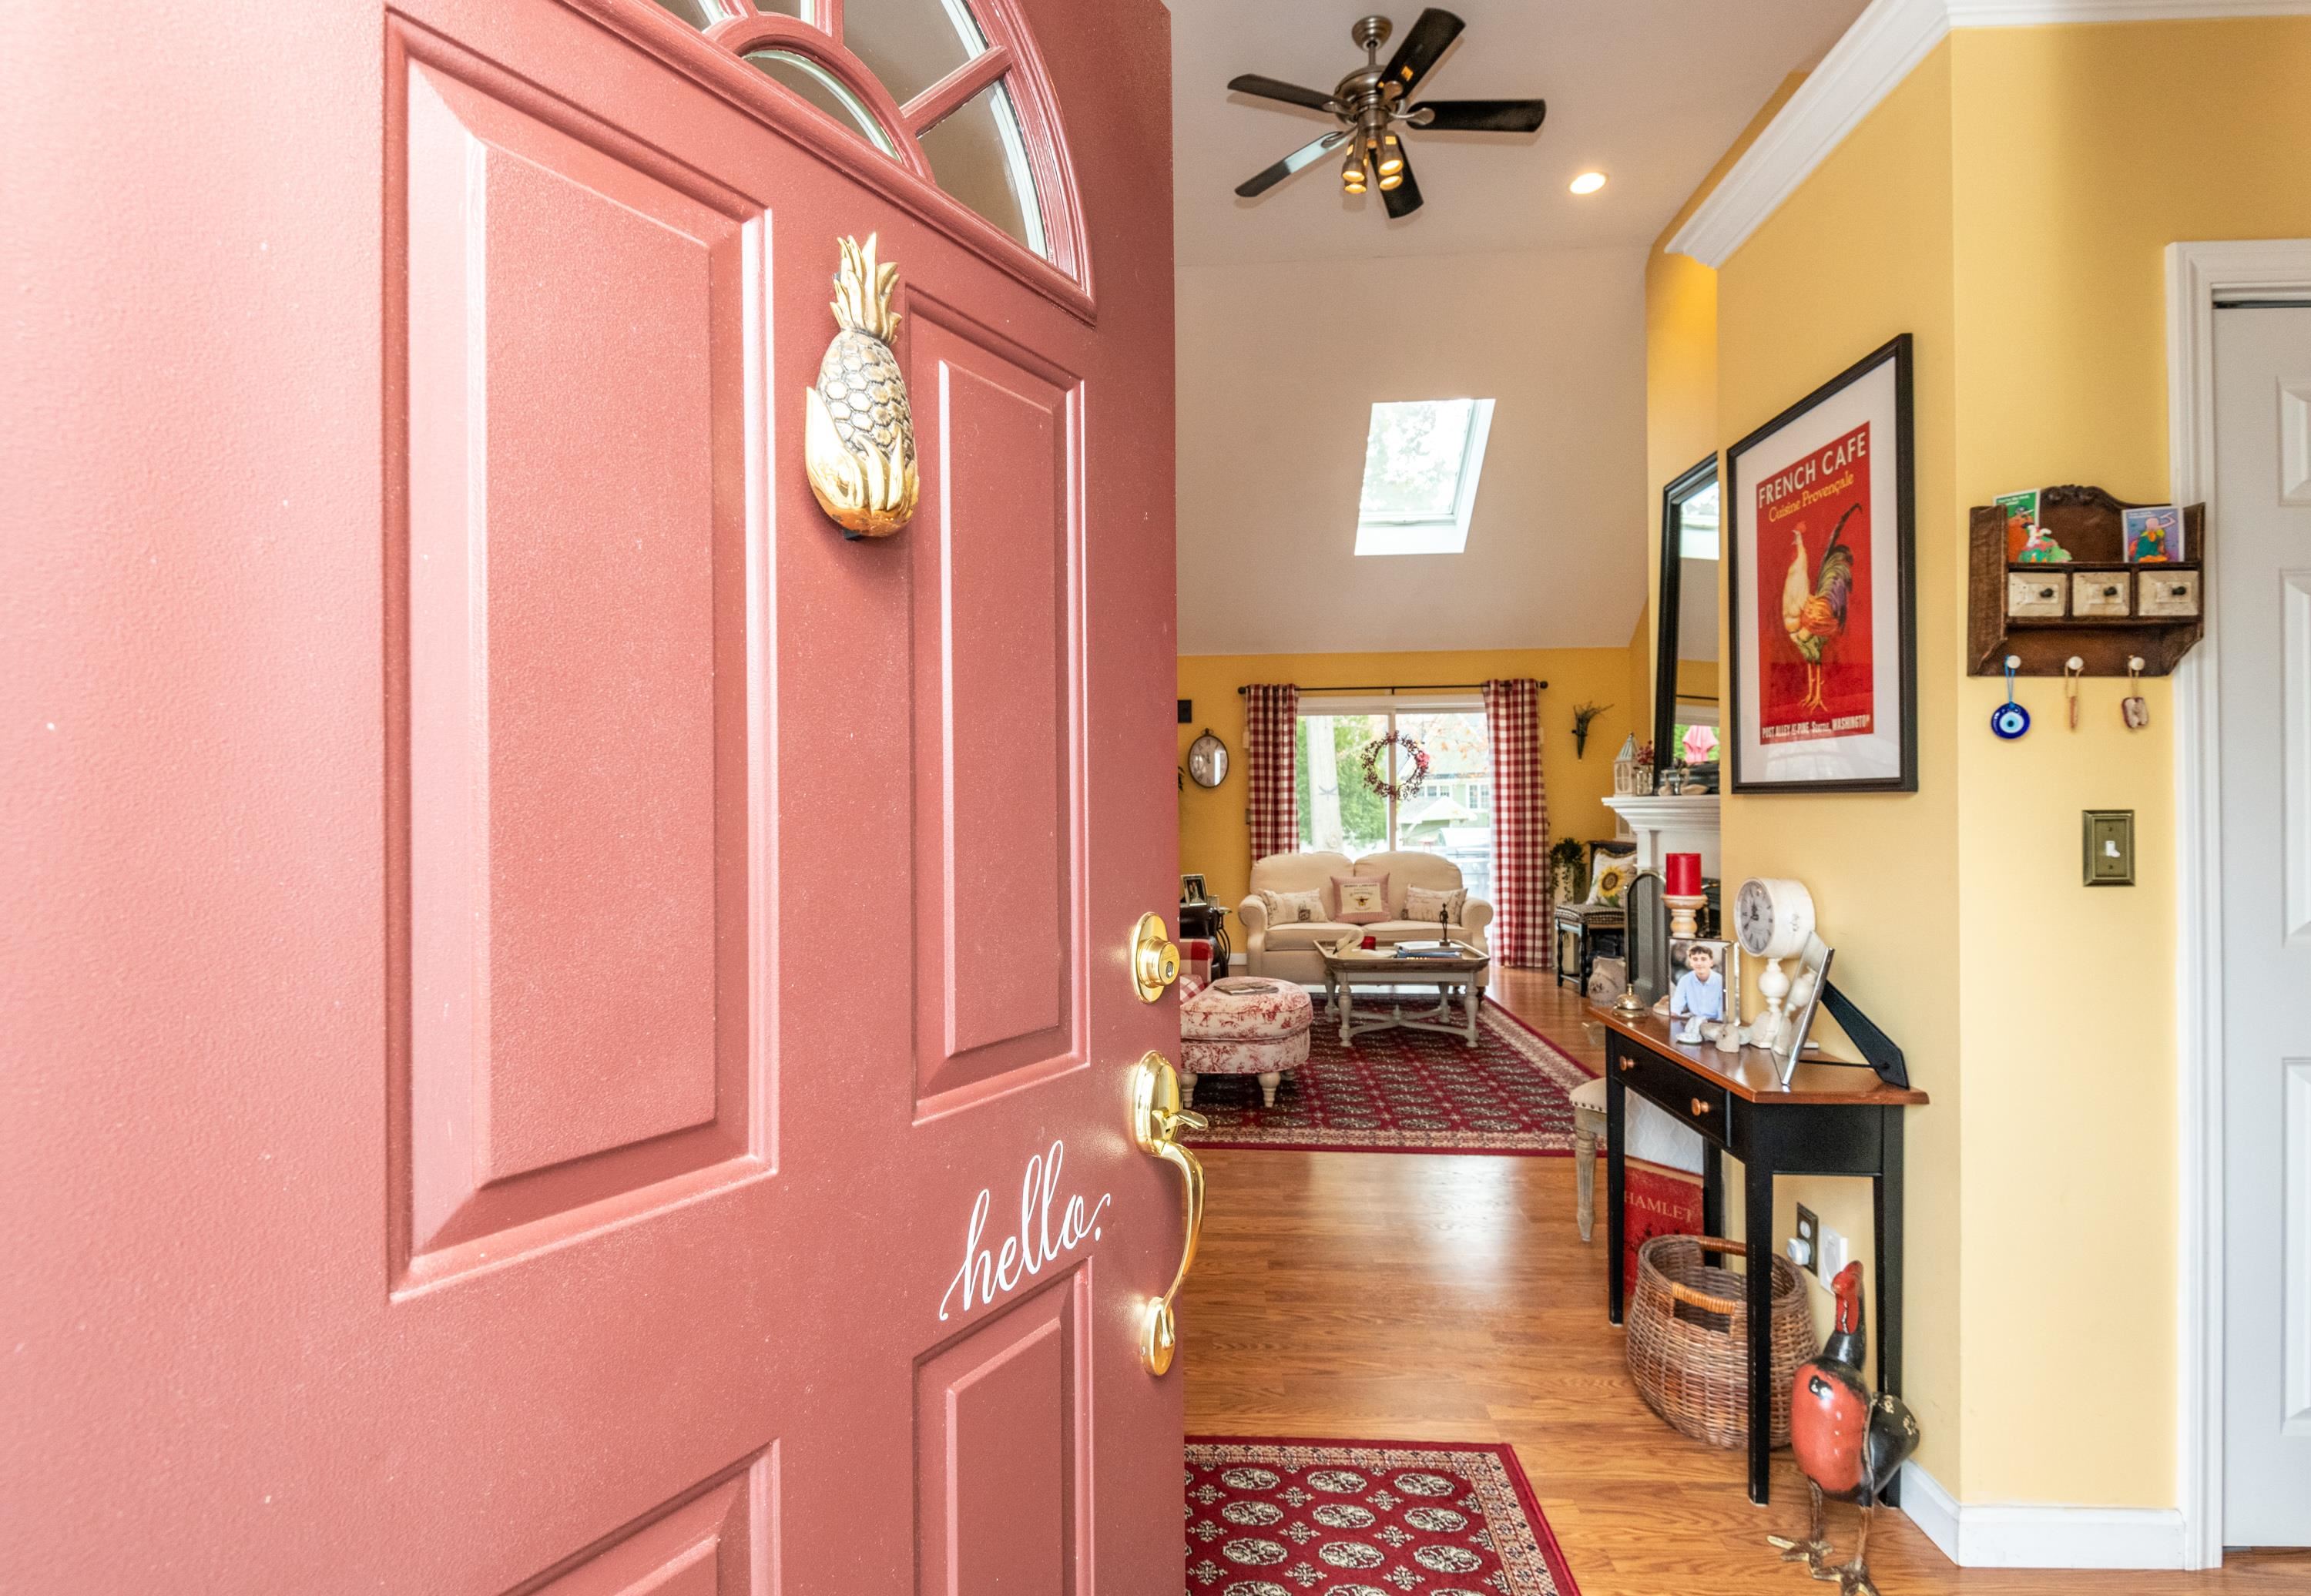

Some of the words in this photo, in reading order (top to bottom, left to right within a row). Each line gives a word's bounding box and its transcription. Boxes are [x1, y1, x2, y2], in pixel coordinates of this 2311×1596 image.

[1759, 460, 1816, 508] FRENCH
[1822, 432, 1866, 475] CAFE
[1769, 499, 1800, 522] Cuisine
[1802, 471, 1854, 507] Provençale
[1625, 1191, 1692, 1222] HAMLET
